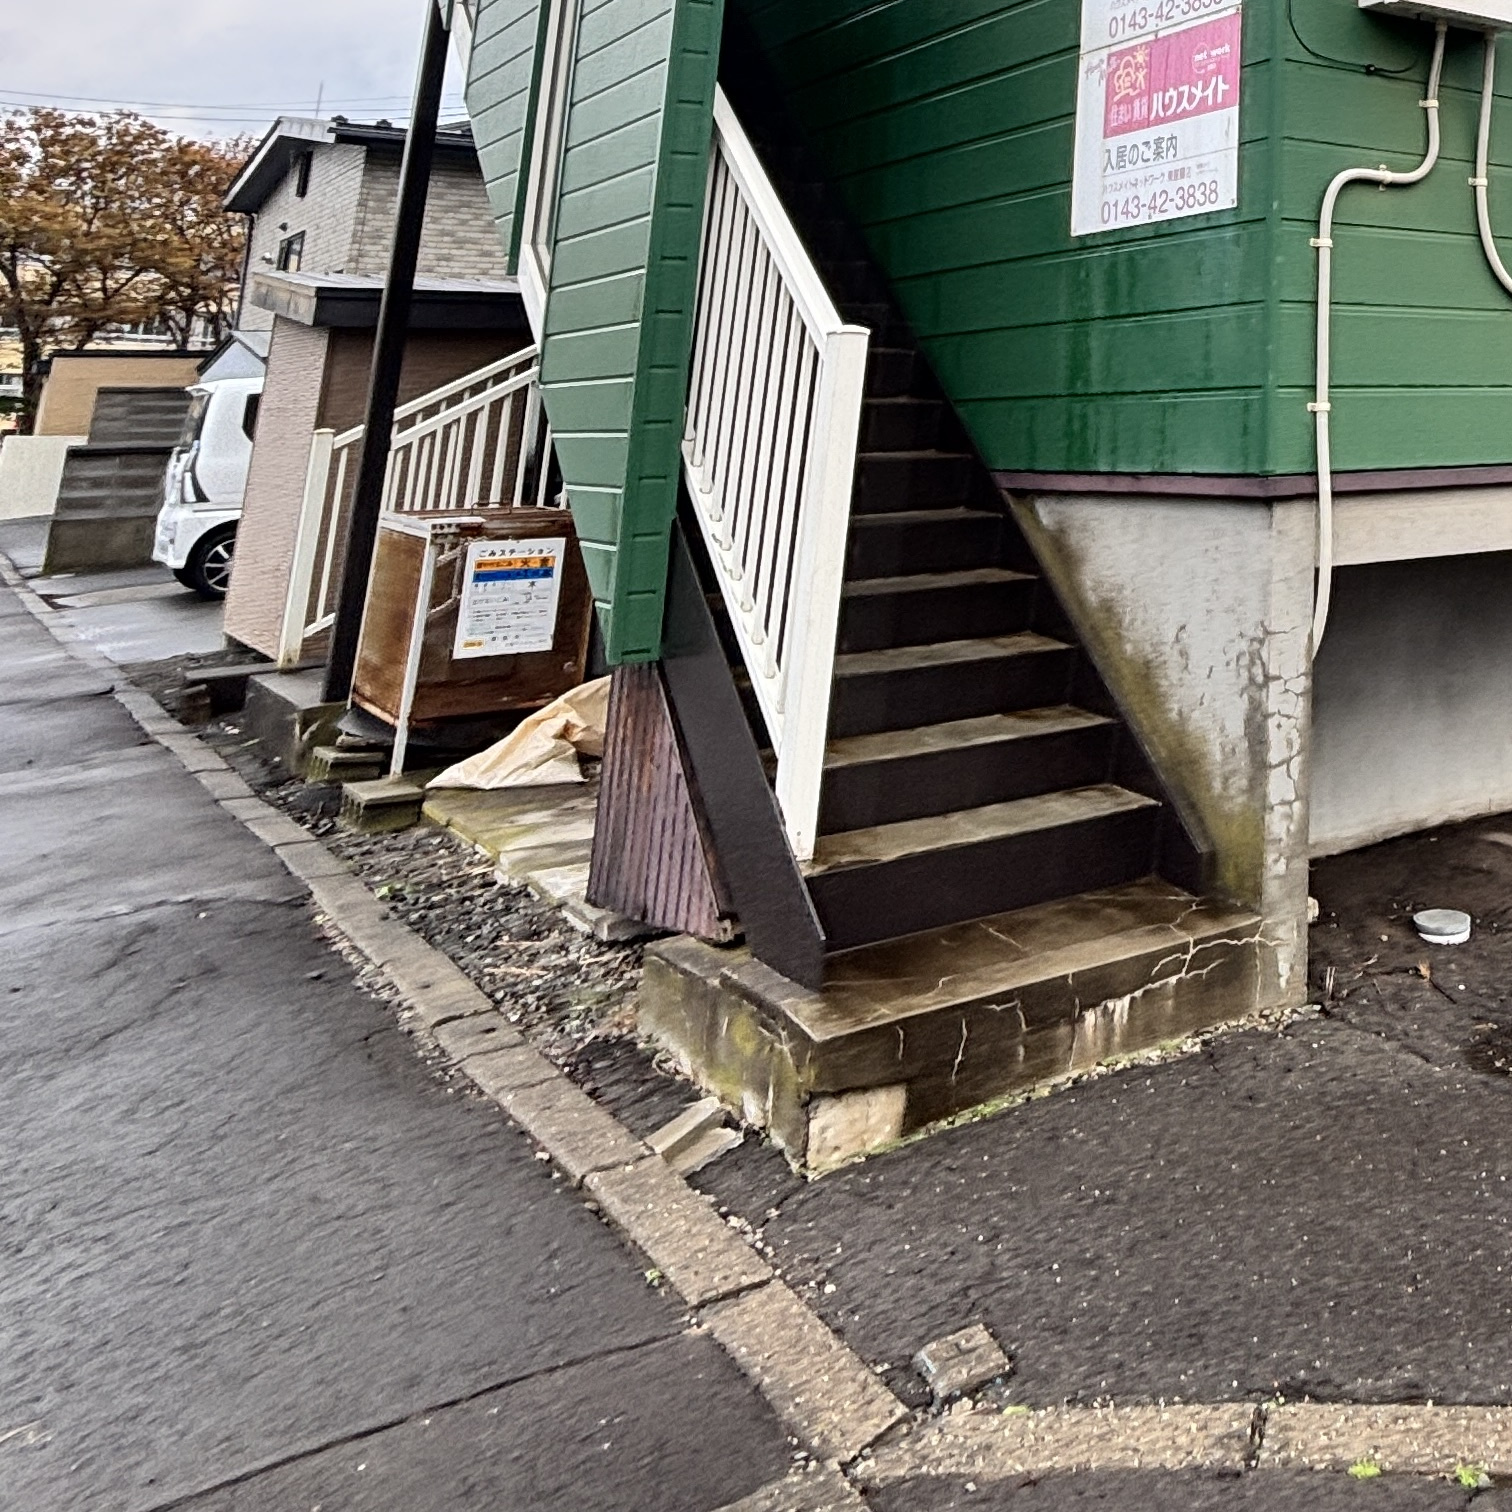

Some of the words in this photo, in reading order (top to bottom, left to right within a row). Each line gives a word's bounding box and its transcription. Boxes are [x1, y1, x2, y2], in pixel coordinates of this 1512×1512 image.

[1150, 75, 1229, 121] ハウスメイト
[1103, 133, 1178, 173] 入居のご案内
[1101, 180, 1219, 224] 0143-42-3838
[479, 547, 554, 557] ごみステーション
